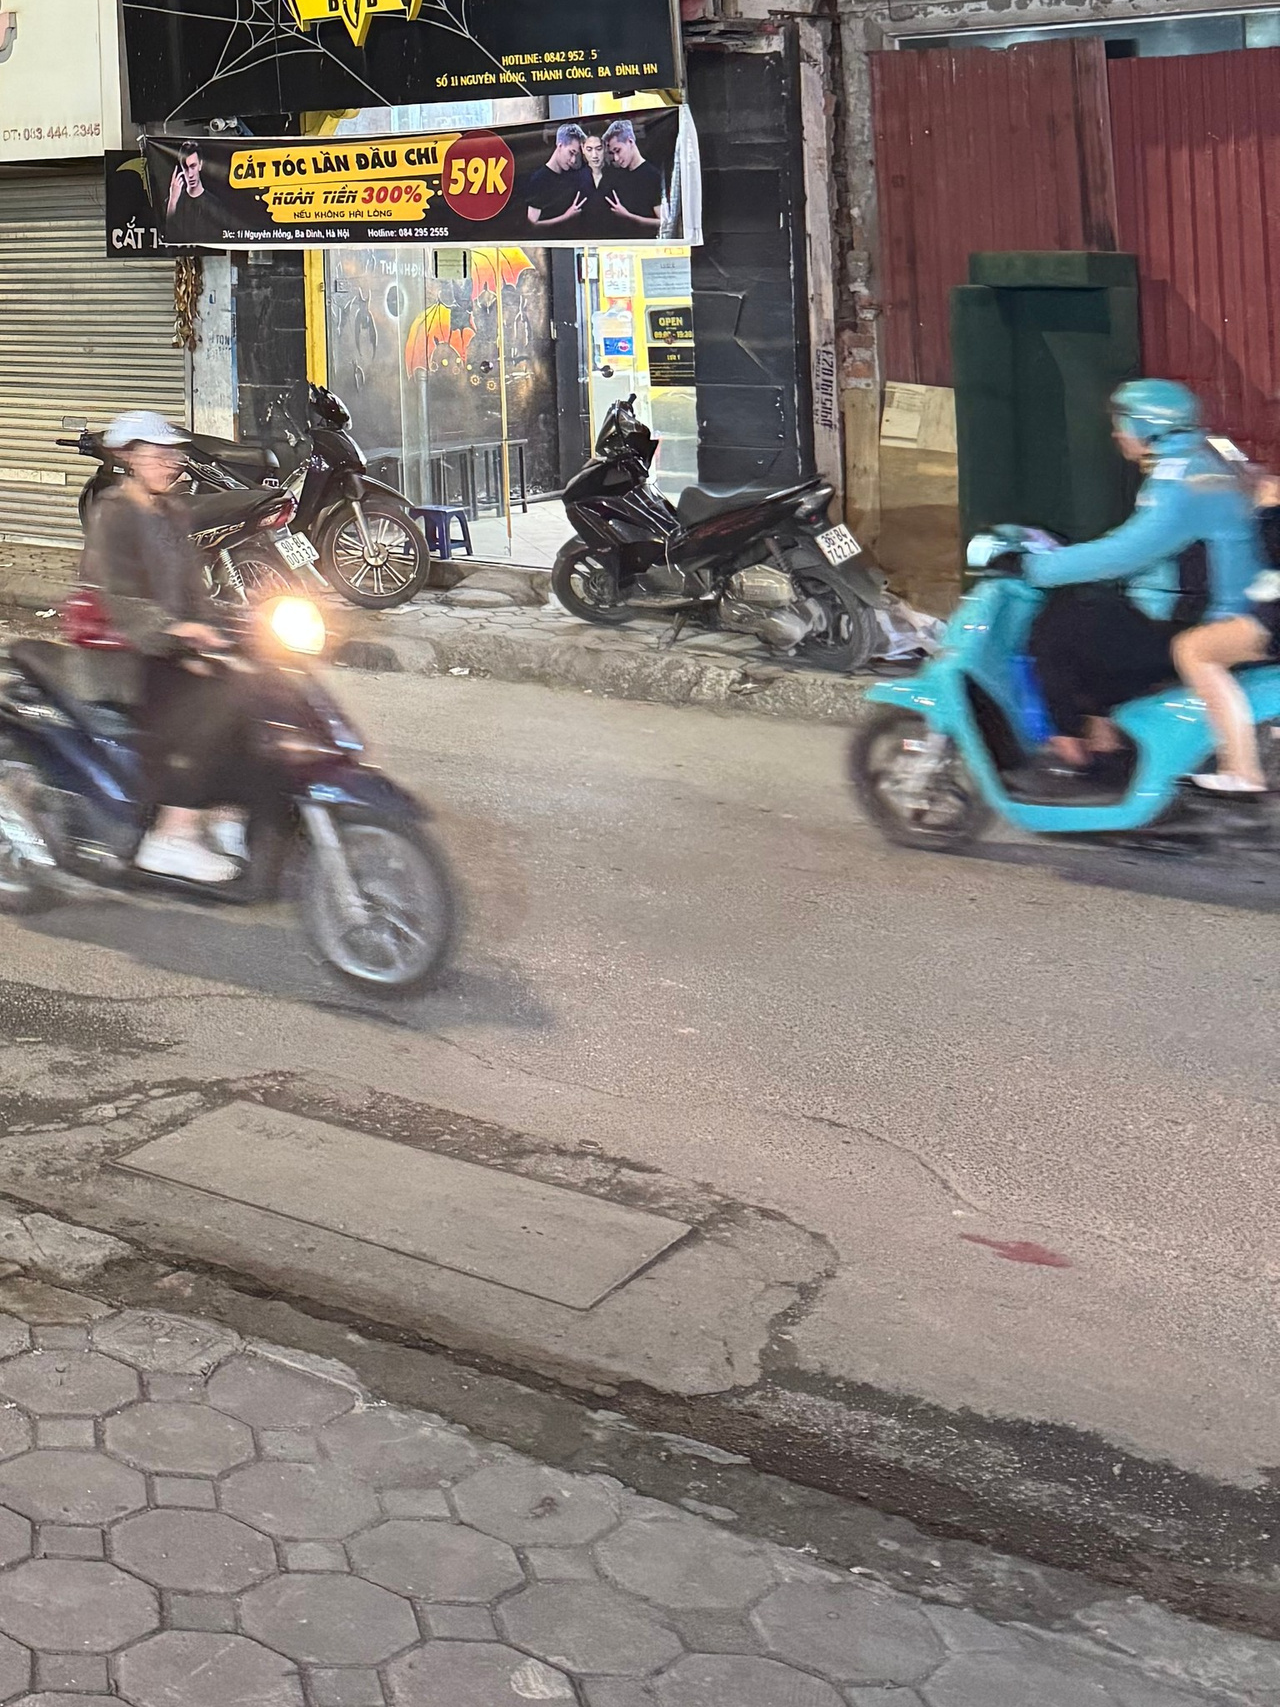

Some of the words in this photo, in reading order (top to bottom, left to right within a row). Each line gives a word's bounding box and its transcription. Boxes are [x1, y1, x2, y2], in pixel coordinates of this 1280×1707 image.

[502, 53, 542, 66] HOTLINE:
[544, 52, 565, 63] 0842
[568, 50, 584, 61] 952
[436, 73, 448, 87] SỐ
[460, 72, 496, 86] NGUYÊN
[531, 68, 562, 81] THÀNH
[598, 66, 611, 77] BA
[643, 63, 658, 74] HN
[233, 153, 266, 179] CẮT
[272, 153, 307, 177] TÓC
[313, 148, 349, 175] LẦN
[356, 146, 397, 171] ĐẦU
[405, 141, 438, 165] CHỈ
[448, 156, 508, 196] 59K
[322, 184, 358, 205] TIỀN
[361, 185, 422, 204] 300%
[293, 209, 311, 219] NẾU
[314, 208, 345, 219] KHÔNG
[349, 208, 364, 218] HÀI
[367, 208, 393, 218] LÒNG
[112, 216, 145, 249] CẮT
[295, 230, 305, 238] Ba
[326, 228, 335, 238] Hà
[337, 228, 350, 239] Nội
[368, 228, 397, 238] Hotline:
[399, 228, 412, 237] 084
[414, 228, 428, 237] 295
[429, 227, 449, 237] 2555
[659, 316, 683, 327] OPEN
